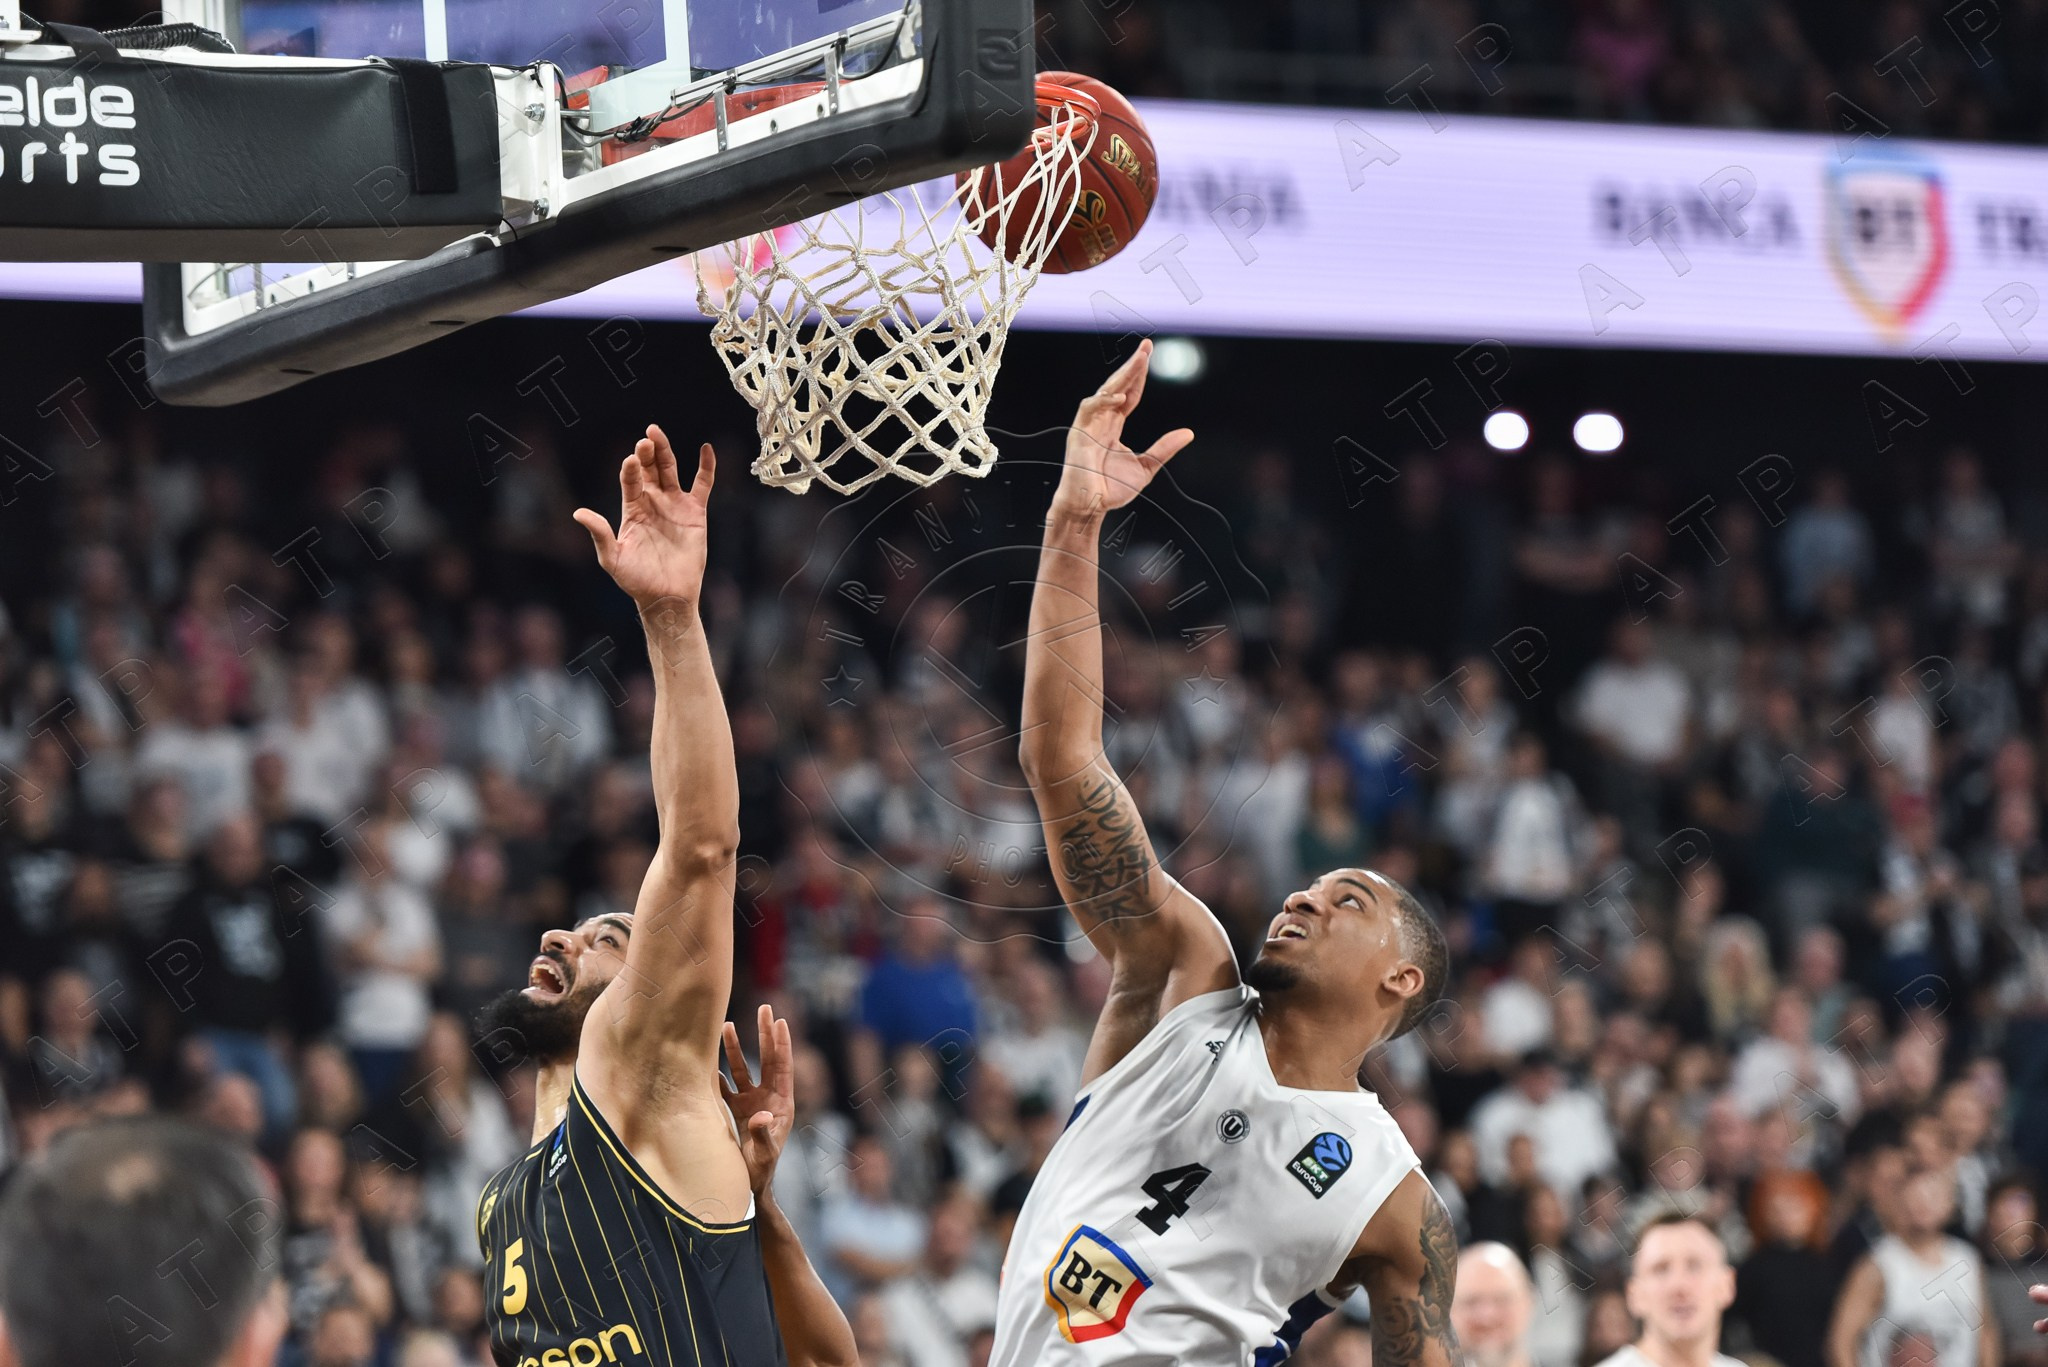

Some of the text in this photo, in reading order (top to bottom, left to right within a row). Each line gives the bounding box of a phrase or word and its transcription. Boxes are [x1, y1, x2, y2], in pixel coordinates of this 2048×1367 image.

[0, 132, 139, 186] rts
[1135, 1162, 1212, 1236] 4
[1292, 1160, 1323, 1194] EuroCup
[502, 1236, 528, 1315] 5
[1059, 1250, 1122, 1309] BT
